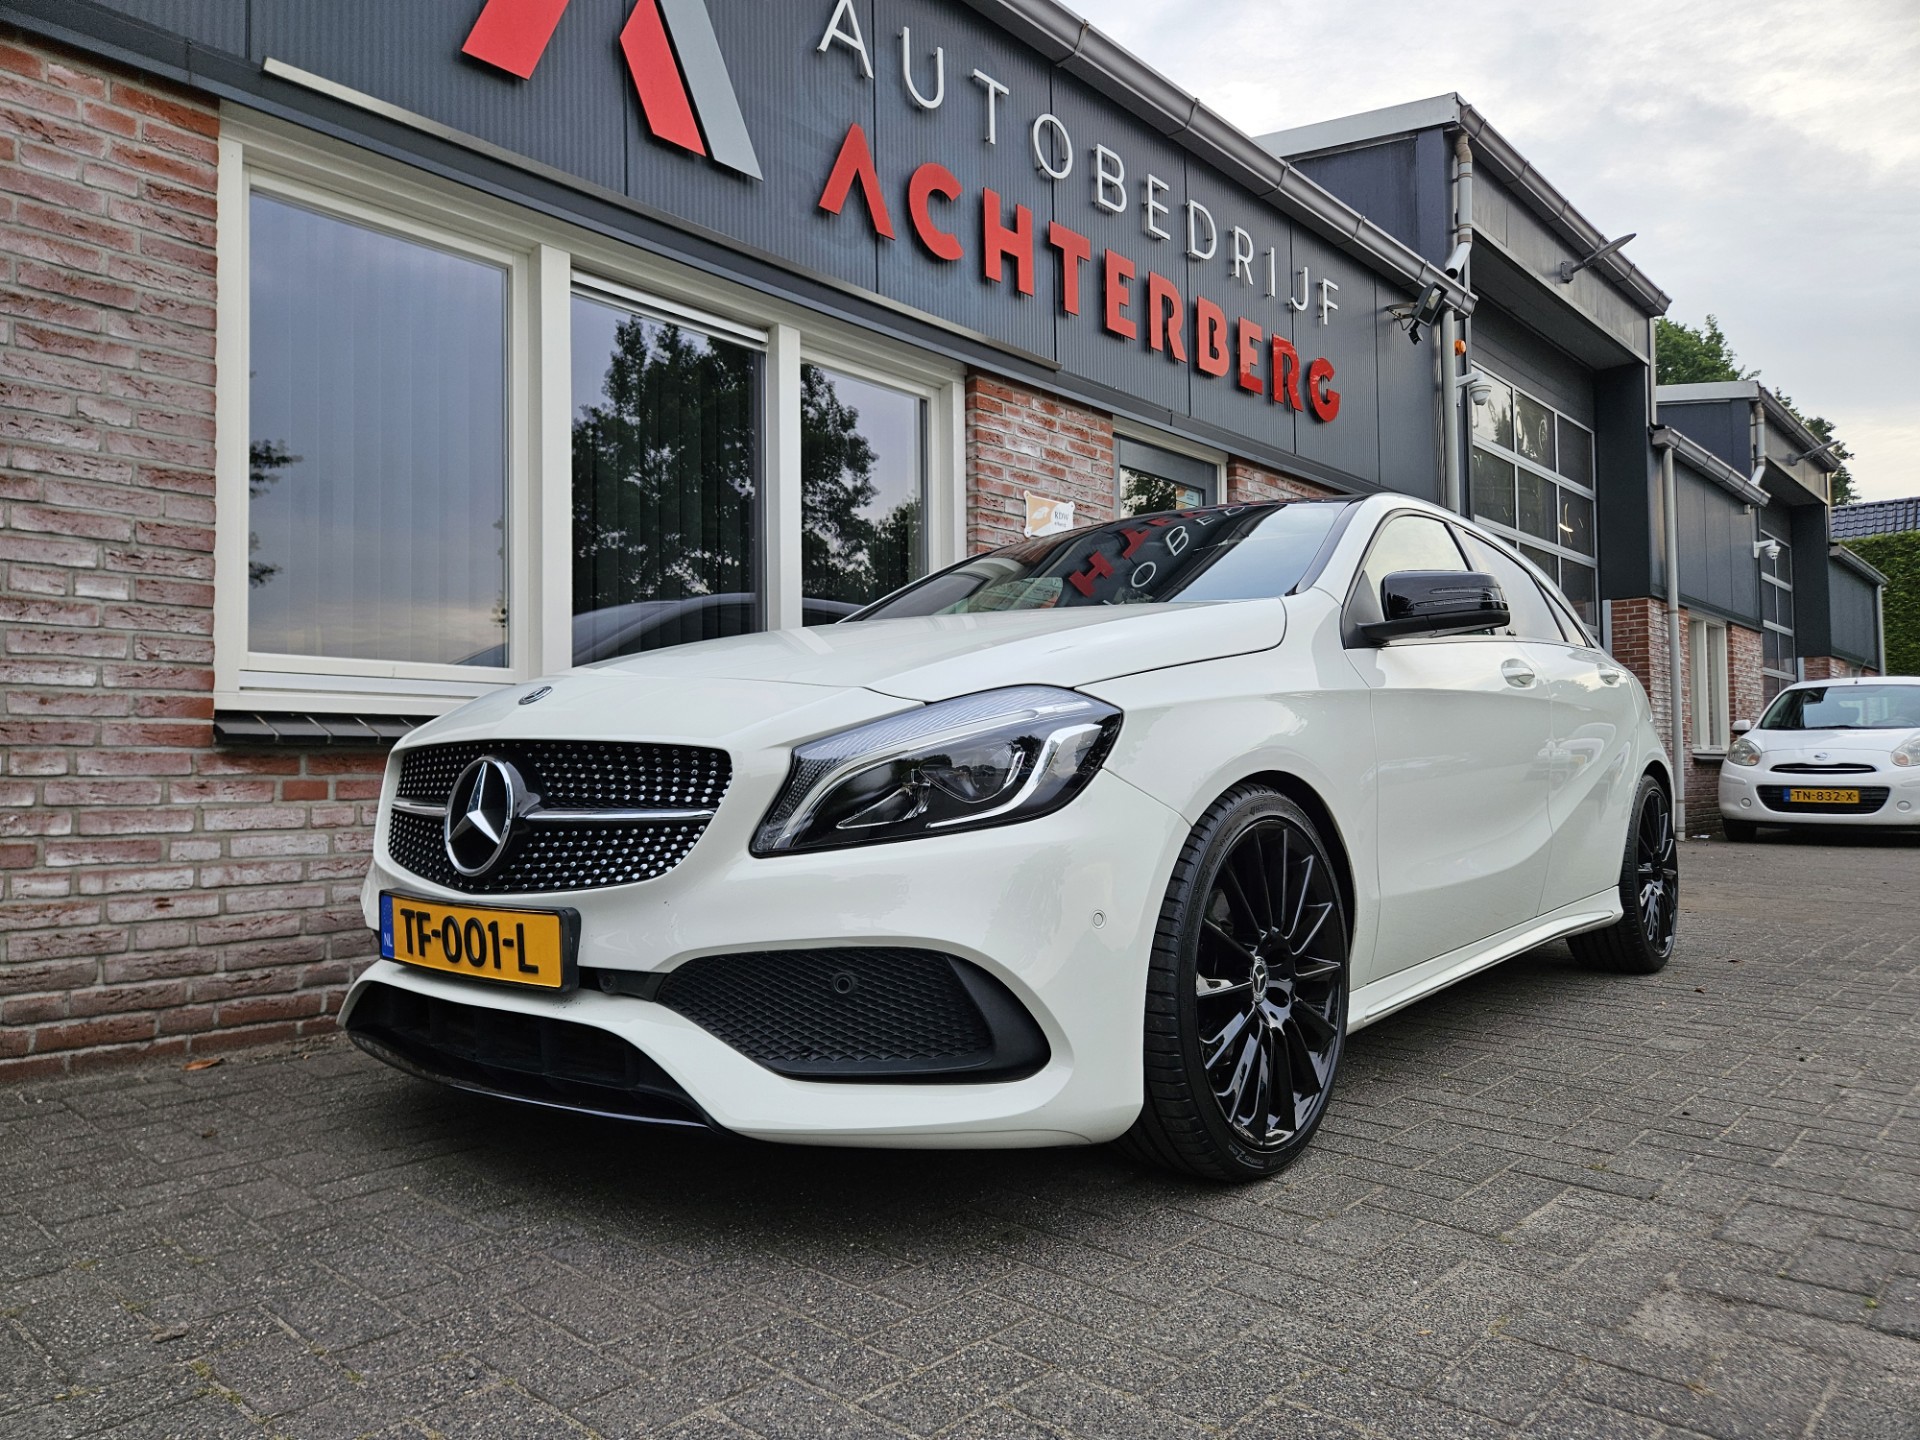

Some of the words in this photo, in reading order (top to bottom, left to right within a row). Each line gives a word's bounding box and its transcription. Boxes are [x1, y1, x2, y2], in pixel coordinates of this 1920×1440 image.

[817, 0, 1338, 325] AUTOBEDRIJF
[818, 123, 1341, 423] ACHTERBERG
[1794, 790, 1854, 802] TN-832-X
[384, 932, 393, 947] NL
[400, 908, 539, 975] TF-001-L
